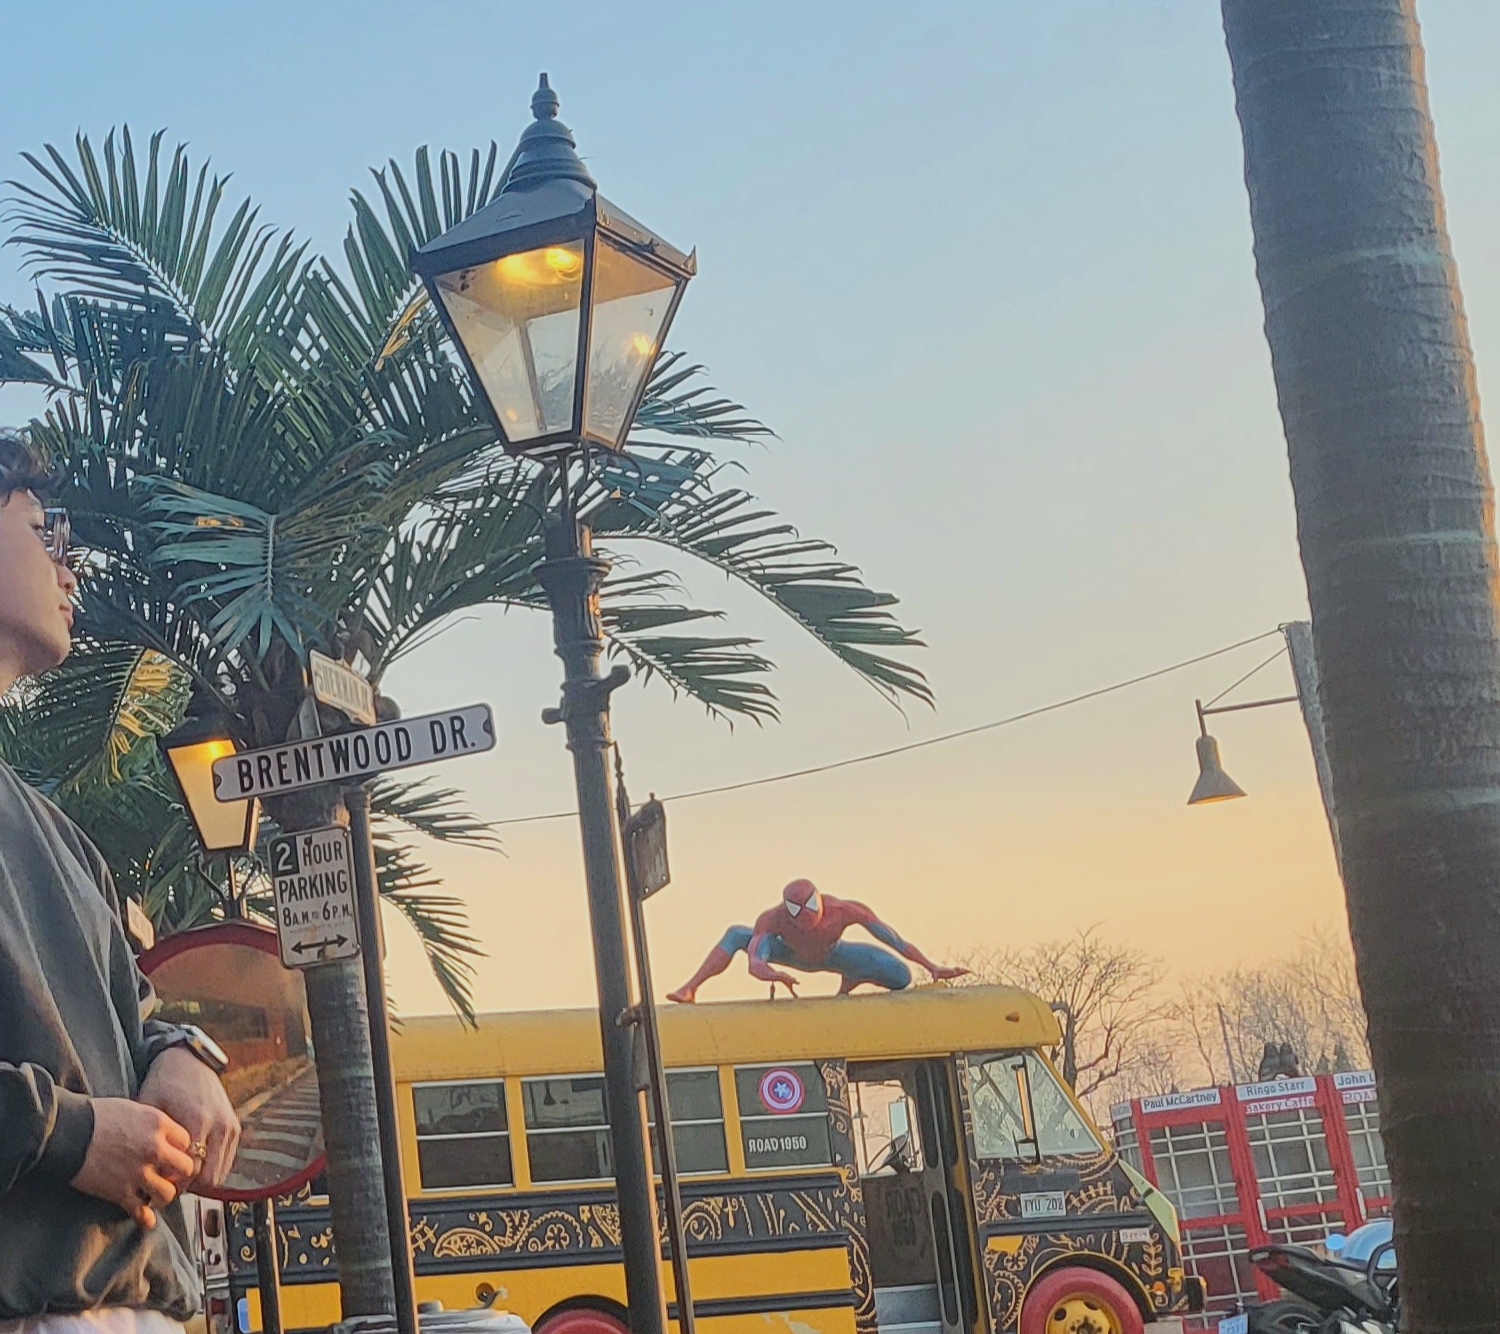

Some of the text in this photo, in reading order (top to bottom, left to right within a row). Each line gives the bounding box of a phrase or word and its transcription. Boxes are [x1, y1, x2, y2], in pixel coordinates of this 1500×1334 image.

[237, 715, 476, 793] BRENTWOOD DR.
[275, 840, 344, 872] 2 HOUR
[278, 869, 348, 904] PARKING
[1246, 1081, 1306, 1097] Ringo Starr
[1338, 1074, 1367, 1086] John
[1143, 1093, 1217, 1110] Paul McCartney
[748, 1135, 807, 1153] ROAD 1950
